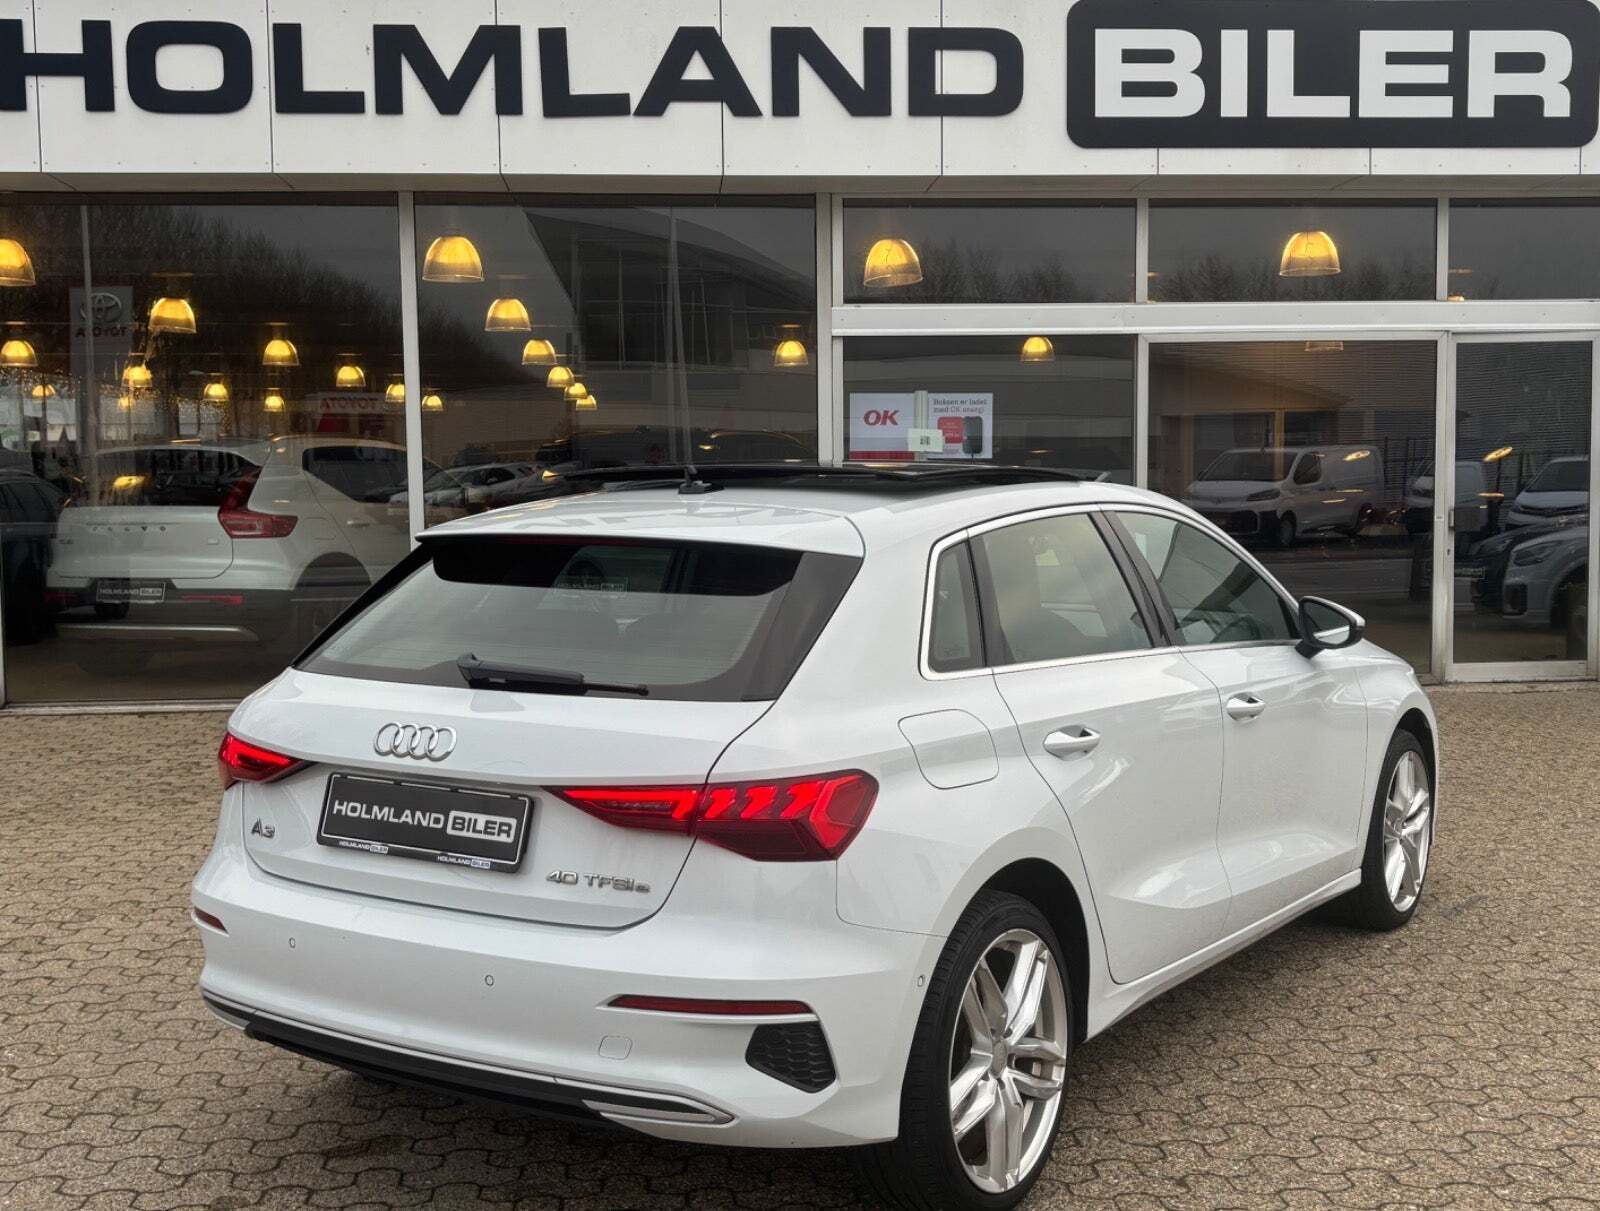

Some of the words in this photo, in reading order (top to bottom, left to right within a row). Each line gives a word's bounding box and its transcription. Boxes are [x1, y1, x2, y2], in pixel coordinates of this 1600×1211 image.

[0, 19, 1023, 117] HOLMLAND
[1094, 28, 1574, 119] BILER
[863, 409, 899, 426] OK
[251, 817, 275, 838] A3
[333, 799, 445, 829] HOLMLAND
[451, 815, 513, 839] BILER
[339, 840, 370, 850] HOLMLAND
[437, 855, 471, 865] HOLMLAND
[546, 869, 579, 885] 40
